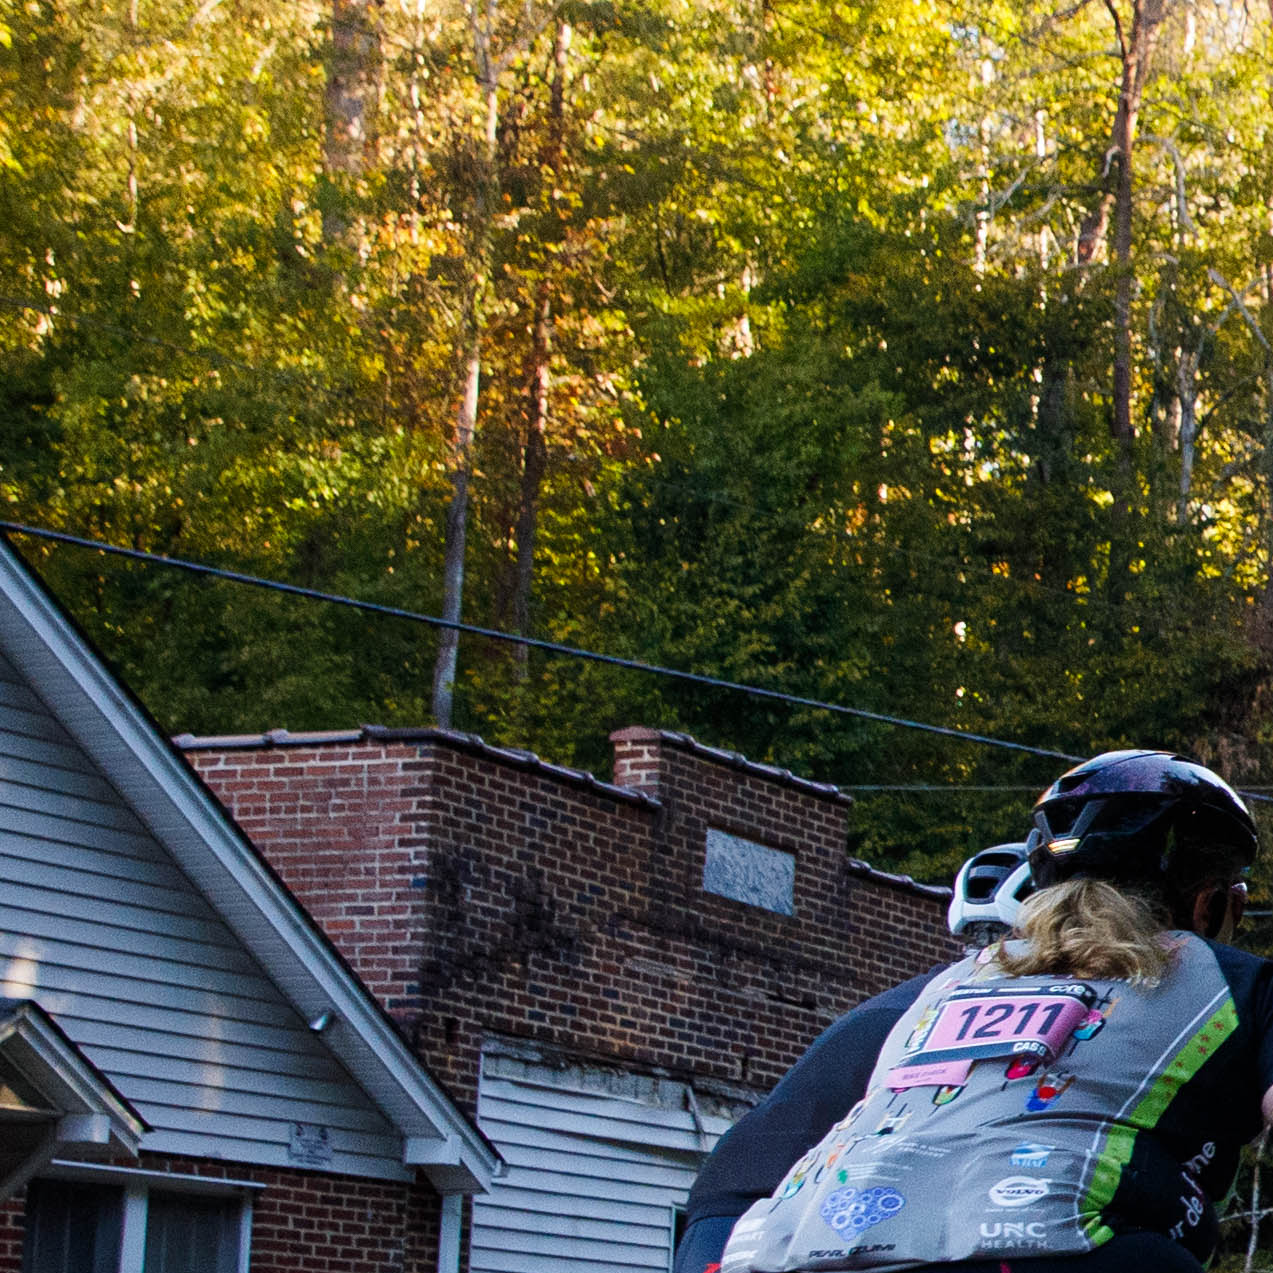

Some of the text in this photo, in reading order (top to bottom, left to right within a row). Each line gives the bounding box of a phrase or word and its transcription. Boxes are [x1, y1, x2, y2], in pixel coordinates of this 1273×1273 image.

[955, 1002, 1067, 1042] 1211
[995, 1187, 1045, 1196] VOLVO
[1179, 1195, 1205, 1228] de
[979, 1221, 1048, 1239] UNC
[980, 1239, 1048, 1250] HEALTH
[808, 1248, 847, 1258] PEARL
